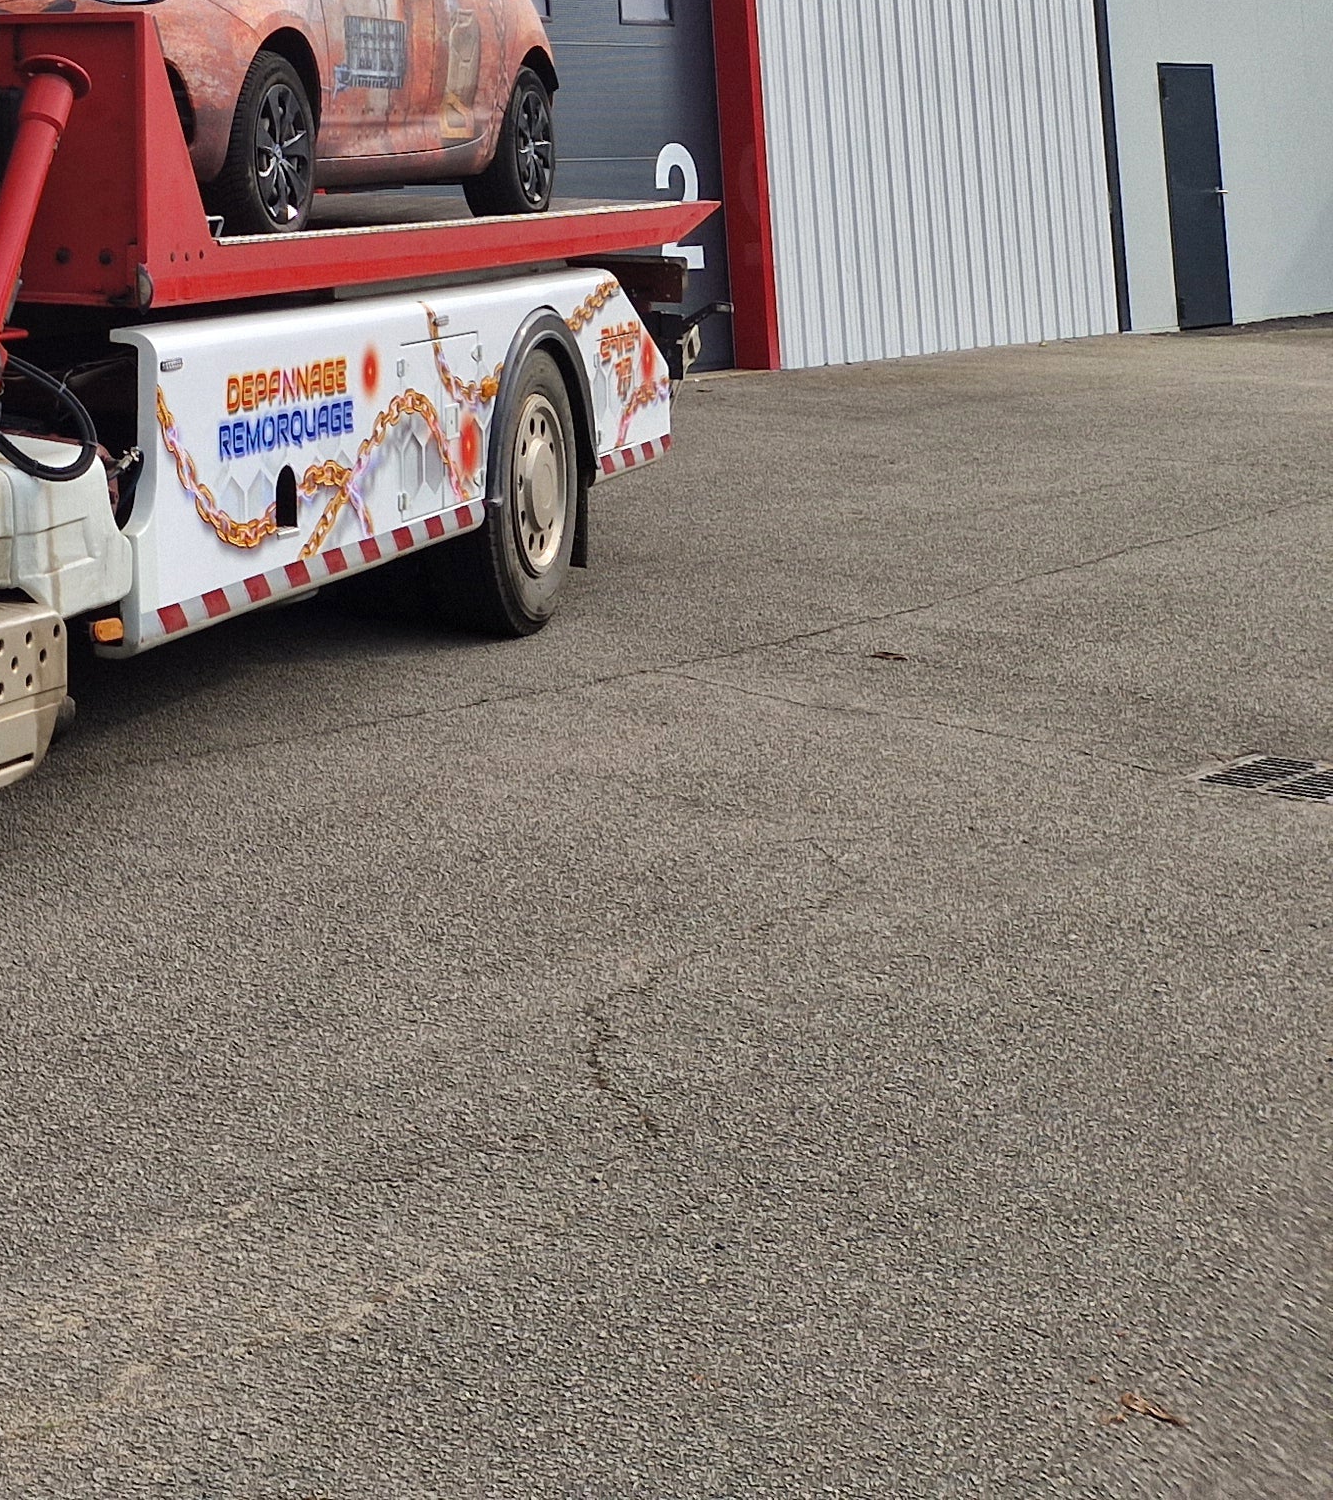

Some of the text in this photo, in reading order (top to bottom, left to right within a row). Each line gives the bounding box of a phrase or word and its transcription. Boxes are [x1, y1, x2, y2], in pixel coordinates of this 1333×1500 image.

[656, 142, 705, 269] 2
[227, 359, 347, 411] DEPANNAGE
[219, 400, 354, 459] REMORQUAGE
